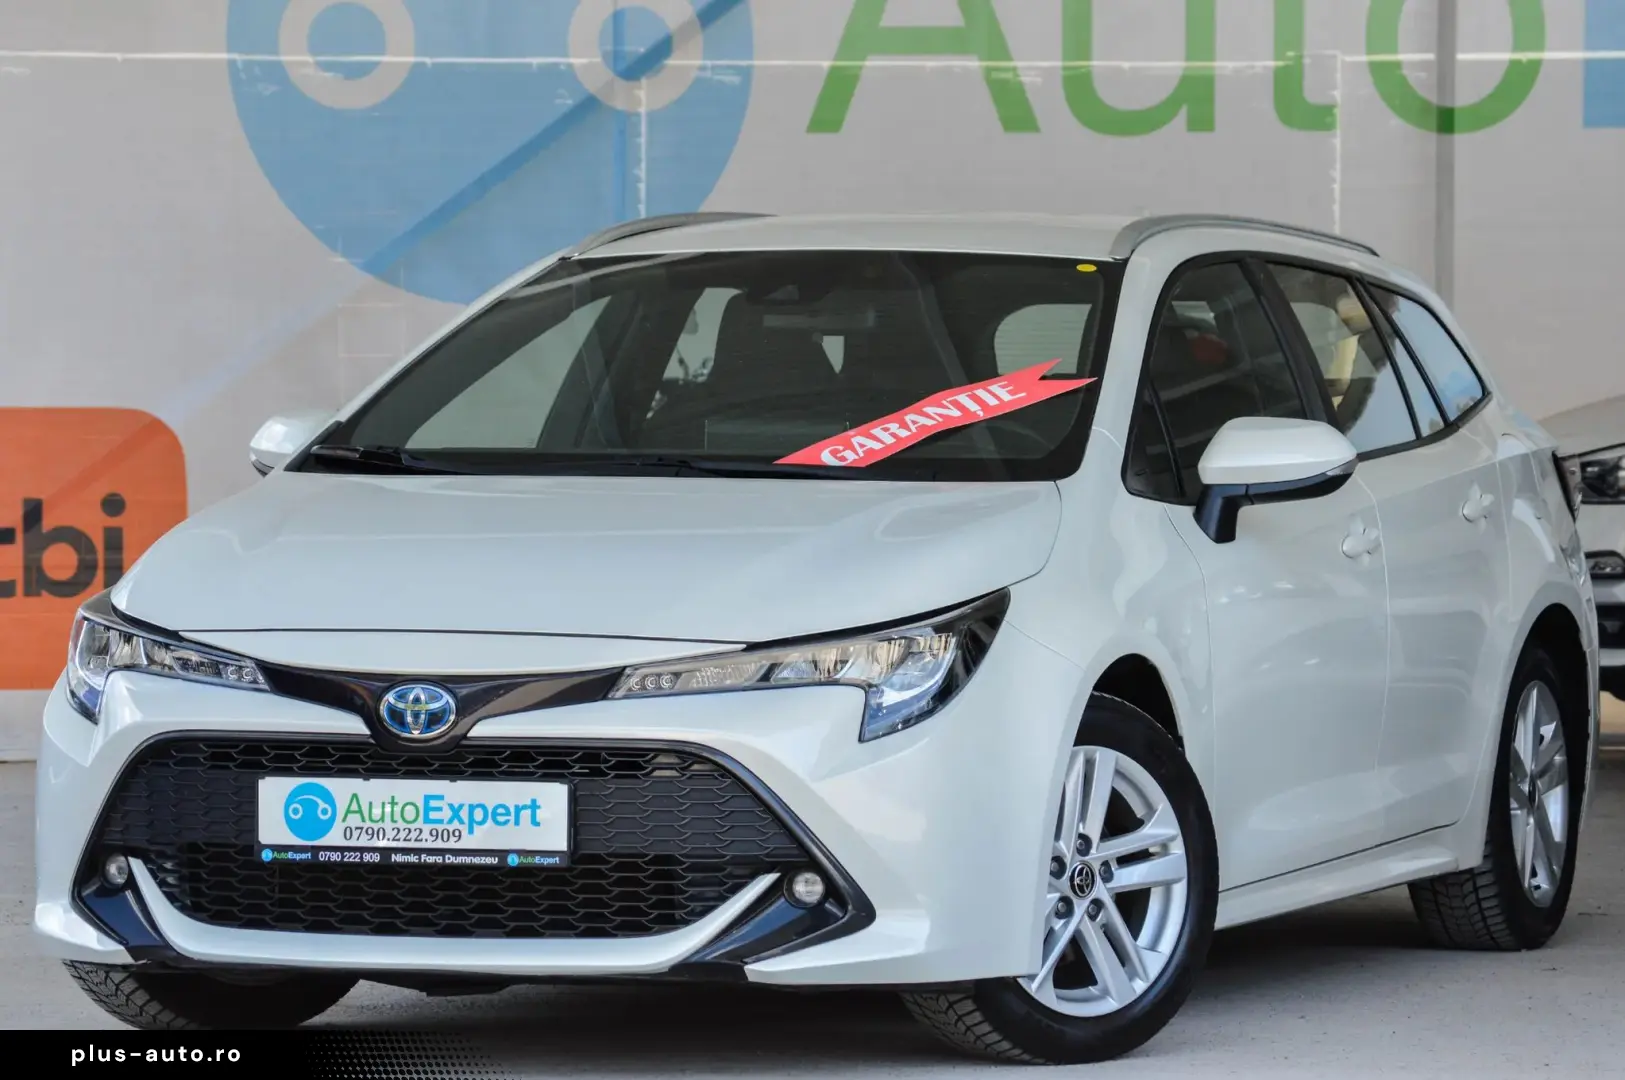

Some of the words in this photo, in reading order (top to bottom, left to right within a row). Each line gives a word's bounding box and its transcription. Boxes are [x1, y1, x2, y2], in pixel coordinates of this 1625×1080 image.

[341, 792, 541, 835] AutoExpert
[343, 826, 462, 843] 0790.222.909
[272, 850, 311, 861] AutoExpert
[318, 851, 341, 862] 0790
[344, 852, 361, 862] 222
[363, 852, 380, 863] 909
[391, 853, 419, 863] Nimic
[421, 853, 443, 864] Fara
[445, 854, 498, 865] Dumnezeu
[519, 855, 560, 866] AutoExpert
